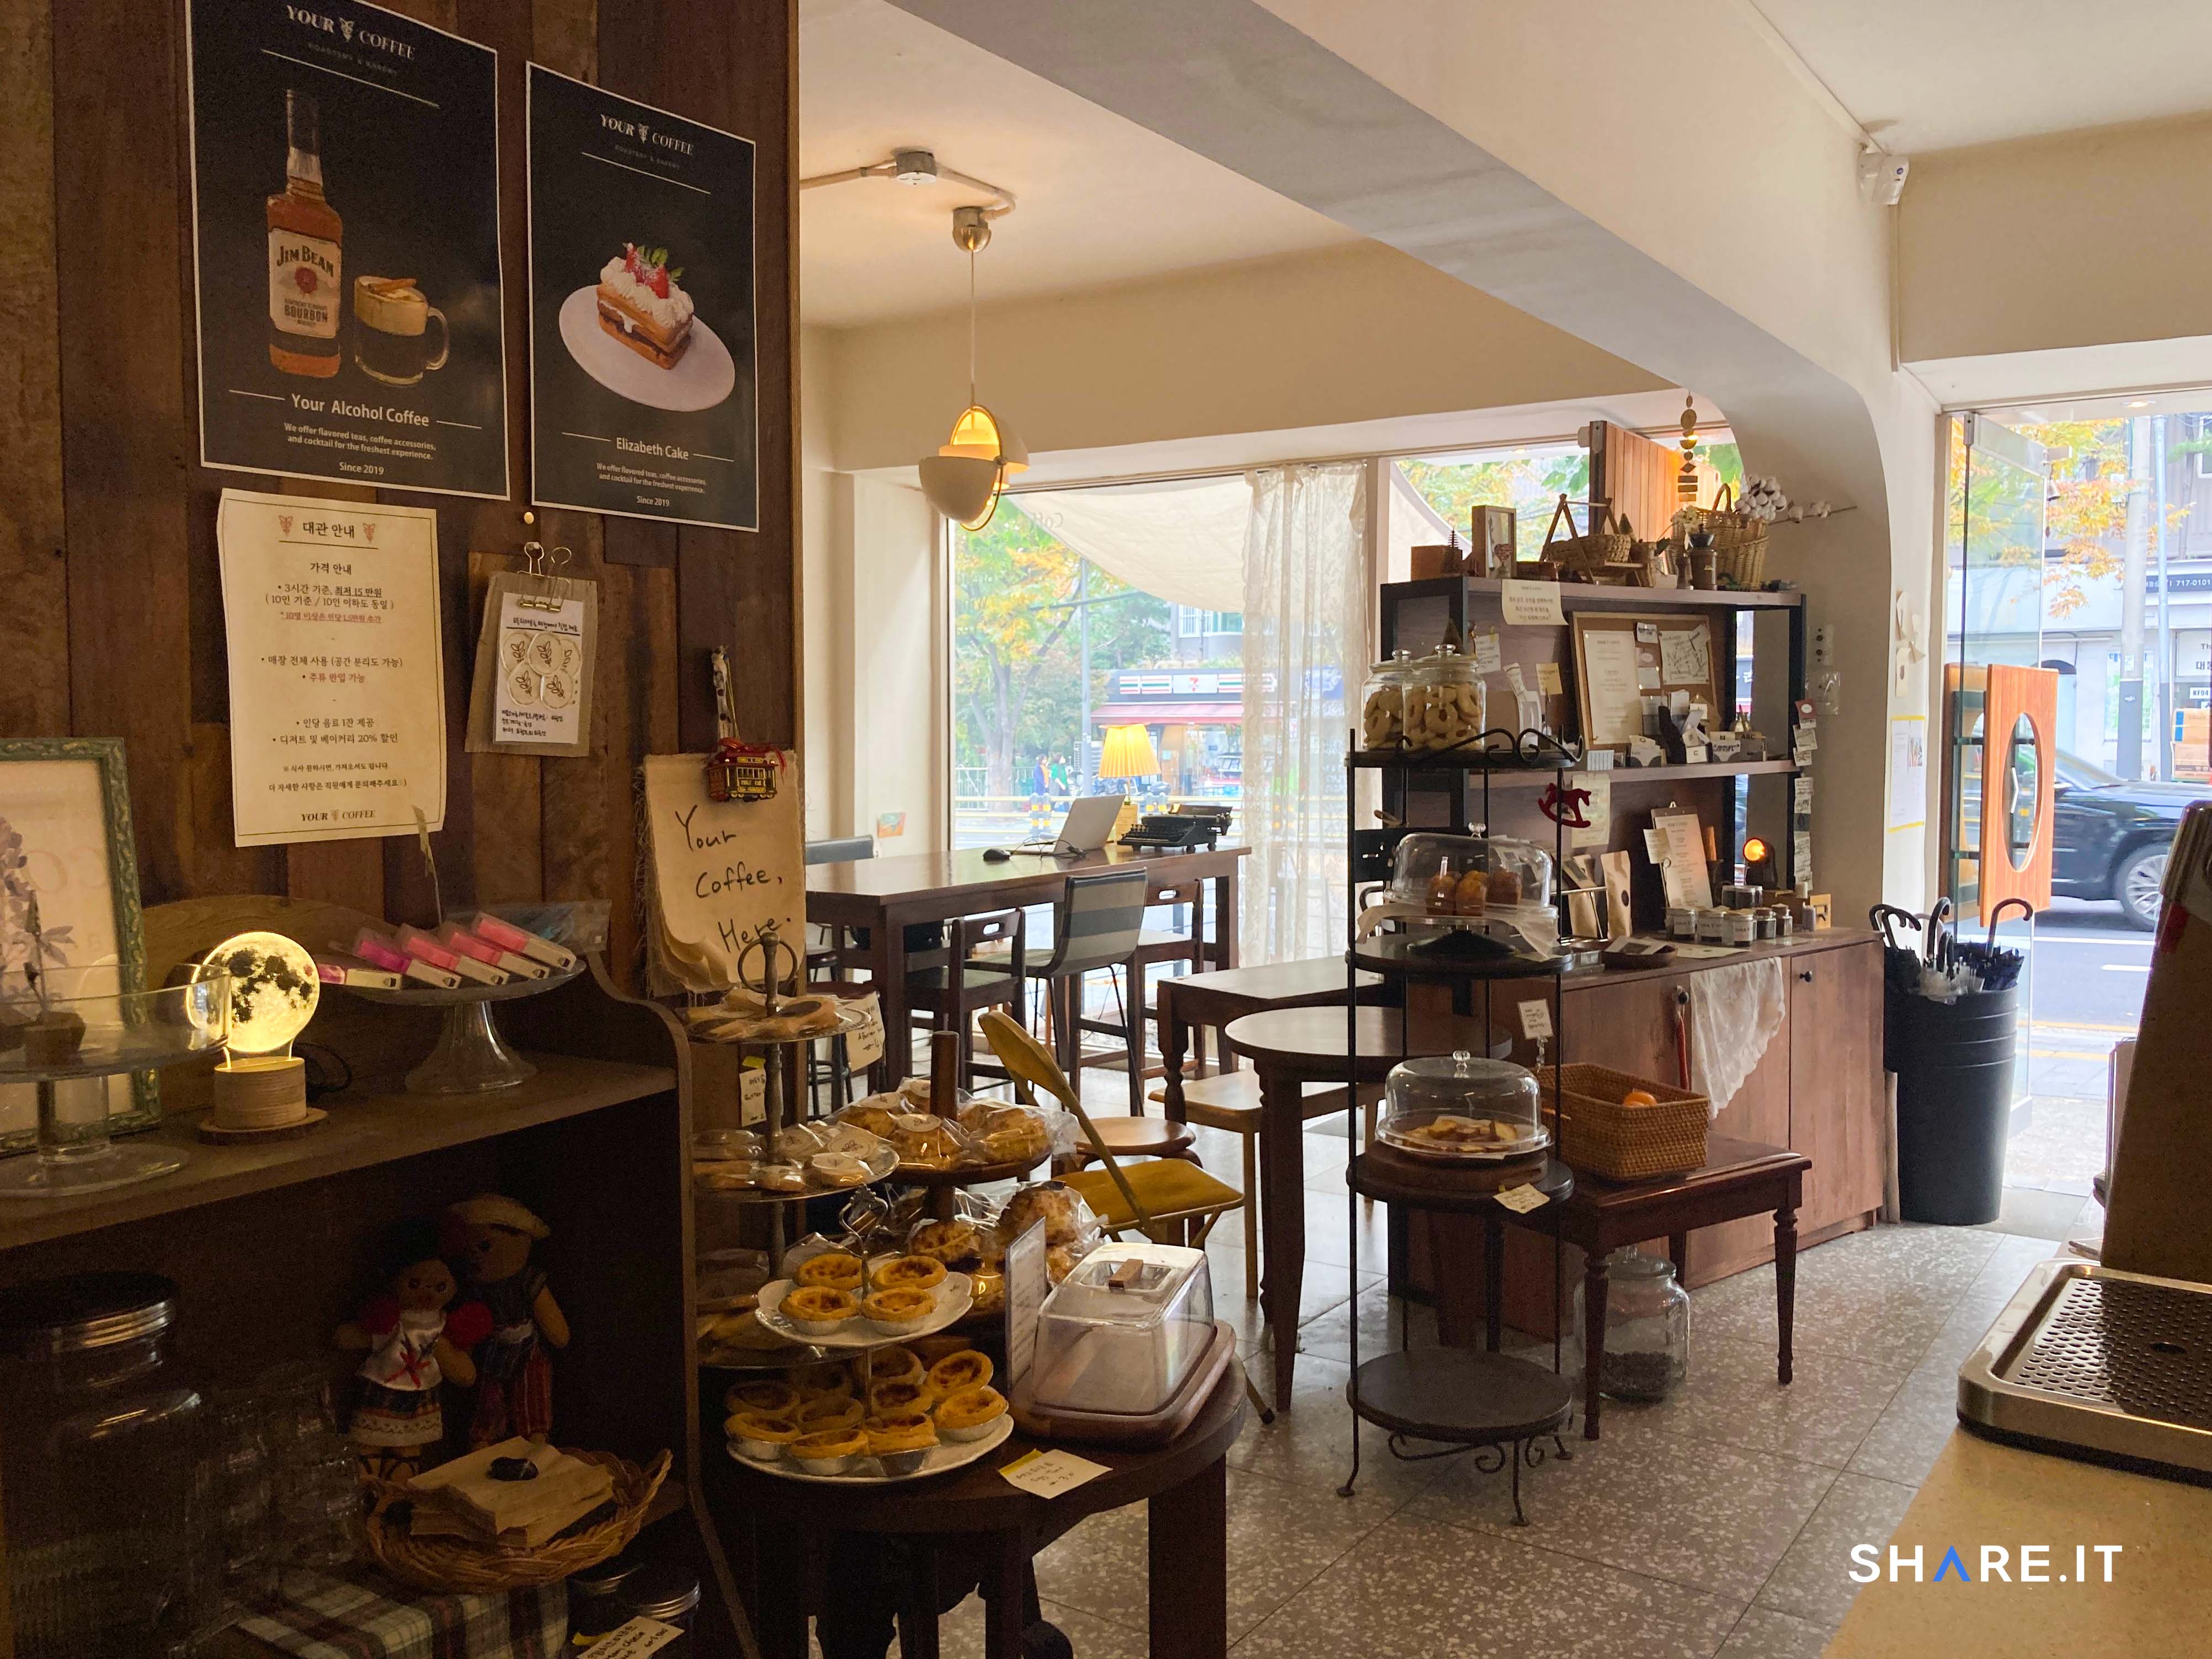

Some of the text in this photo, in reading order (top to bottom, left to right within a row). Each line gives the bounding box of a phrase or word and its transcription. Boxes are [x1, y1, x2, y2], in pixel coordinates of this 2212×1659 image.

[287, 5, 415, 60] YOUR COFFEE
[600, 113, 694, 156] YOUR COFFEE
[284, 304, 328, 323] BOURBON
[291, 393, 429, 426] Your Alcohol Coffee
[284, 423, 436, 451] We offer flavored teas, coffee accessories,
[304, 437, 333, 447] cocktail
[361, 444, 390, 455] freshest
[392, 450, 433, 460] experience.
[616, 437, 689, 460] Elizabeth Cake
[340, 462, 384, 475] Since 2019
[622, 466, 644, 476] flavored
[659, 473, 676, 481] coffee
[611, 475, 633, 483] cocktail
[653, 480, 674, 489] freshest
[637, 495, 670, 506] Since 2019
[303, 521, 354, 538] 대관 안내
[310, 562, 351, 575] 가격 안내
[284, 584, 309, 594] 3시간
[334, 586, 351, 596] 최저
[354, 588, 363, 596] 15
[365, 588, 382, 597] 만원
[272, 595, 290, 605] 10인
[294, 595, 312, 606] 기준
[323, 598, 340, 607] 10인
[343, 598, 369, 608] 이하도
[371, 600, 387, 610] 동일
[268, 655, 287, 665] 매장
[290, 657, 308, 666] 전체
[311, 657, 328, 667] 사용
[354, 658, 379, 667] 분리도
[310, 673, 365, 683] 주류 반입 가능
[303, 718, 375, 728] 인당 음료 1잔 제공
[280, 733, 398, 745] 디저트 및 베이커리 20% 할인
[269, 783, 275, 792] 더
[278, 783, 299, 792] 자세한
[301, 782, 323, 791] 사항은
[325, 781, 353, 790] 직원에게
[302, 810, 375, 822] YOUR COFFEE
[675, 804, 737, 852] Your
[695, 861, 783, 899] Coffee,
[718, 917, 791, 953] Here.
